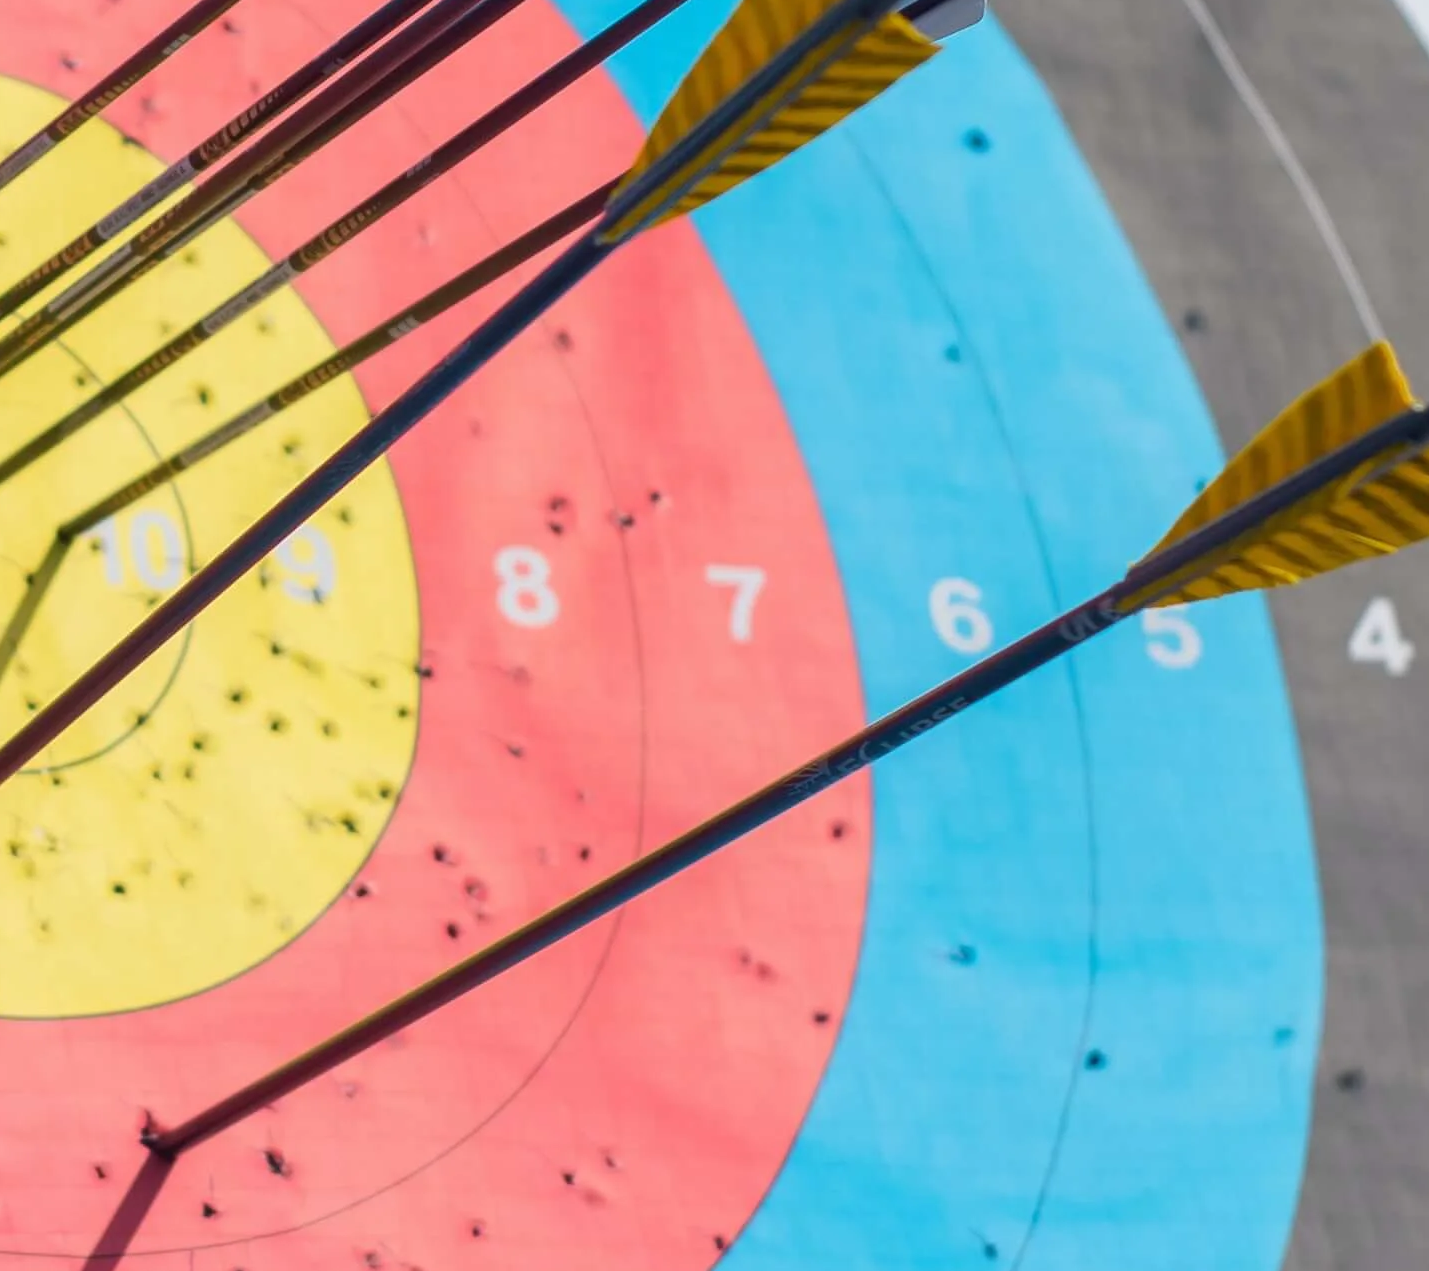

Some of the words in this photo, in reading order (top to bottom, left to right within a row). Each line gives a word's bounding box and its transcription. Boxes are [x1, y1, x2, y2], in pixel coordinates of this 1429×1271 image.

[84, 509, 185, 591] 10
[272, 521, 339, 607] 9
[494, 546, 559, 628] 8
[706, 564, 767, 642] 7
[929, 578, 992, 654] 6
[1142, 603, 1203, 670] 5
[1350, 599, 1413, 673] 4
